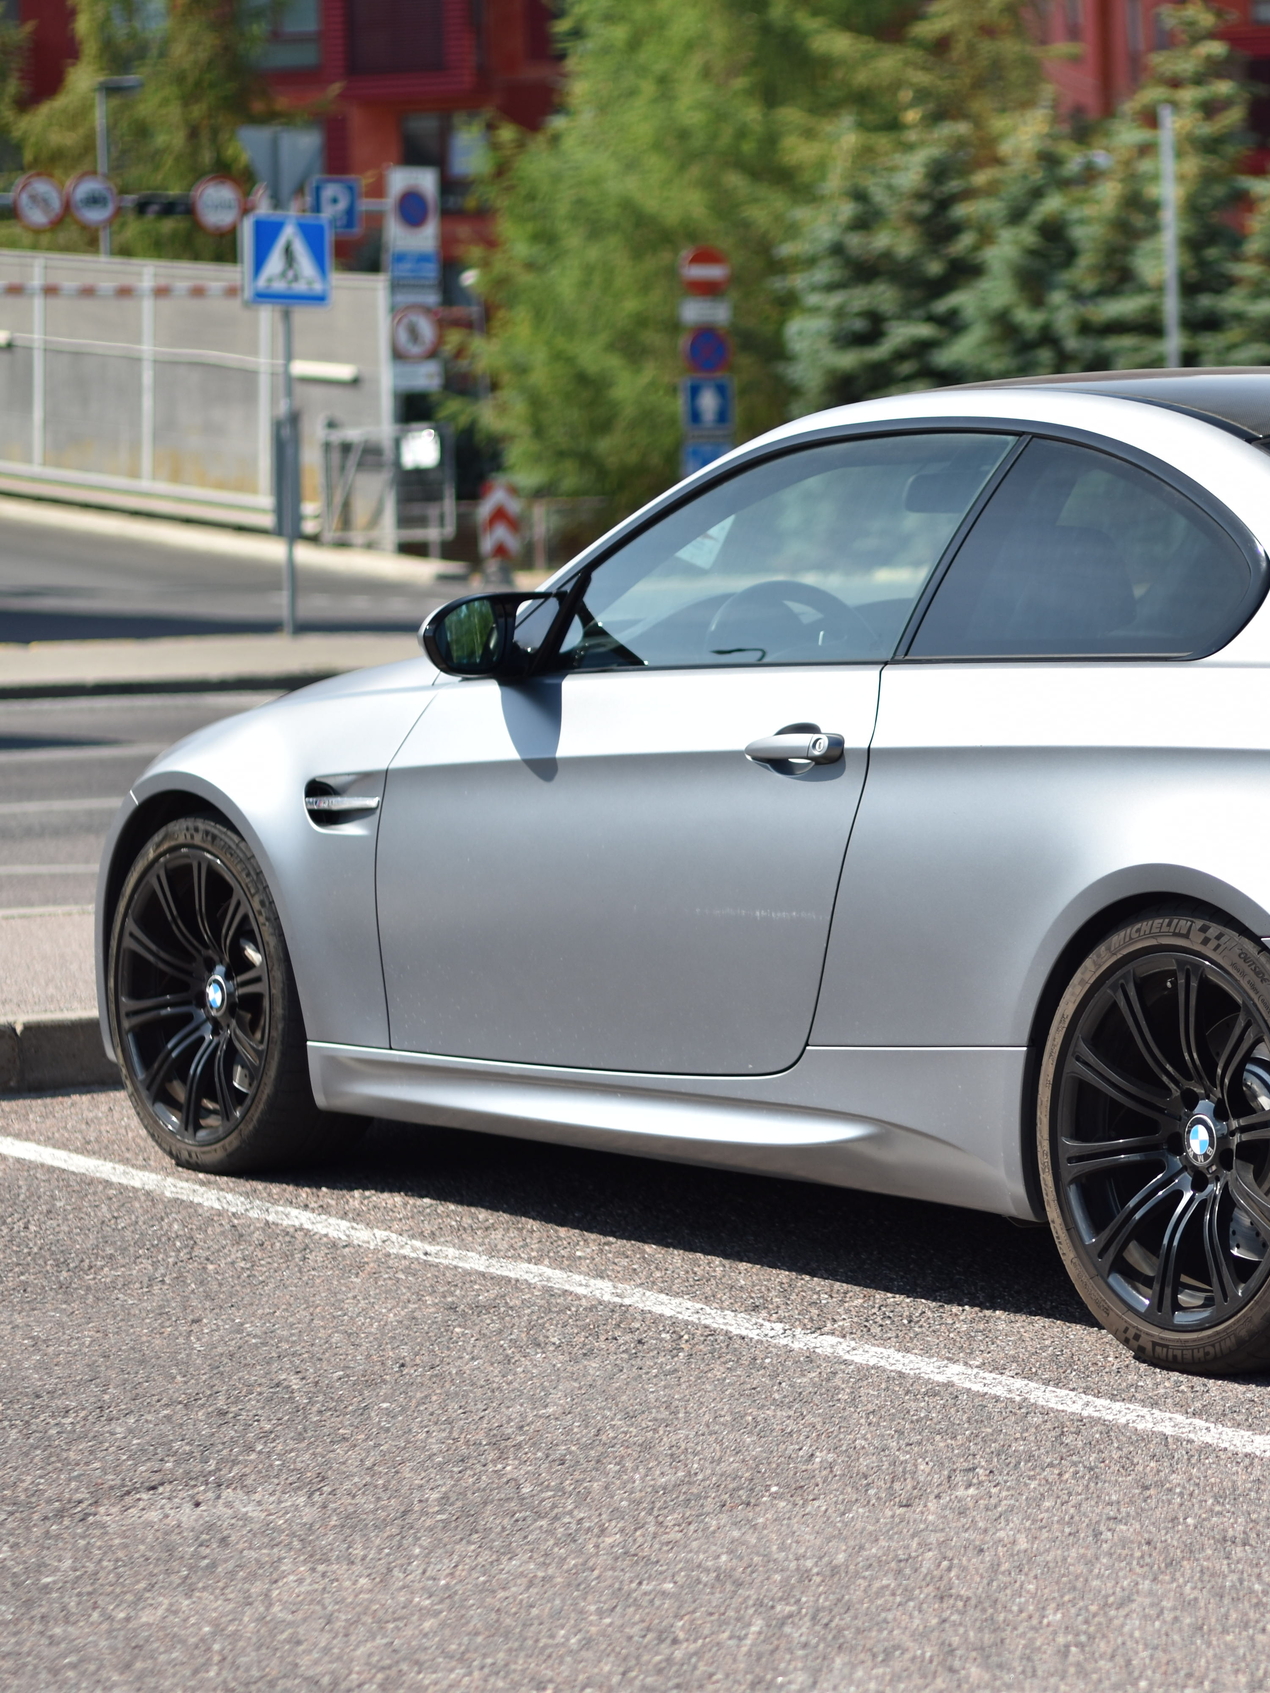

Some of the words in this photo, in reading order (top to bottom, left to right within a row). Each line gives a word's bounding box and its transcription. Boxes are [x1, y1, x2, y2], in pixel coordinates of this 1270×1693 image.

[1111, 918, 1193, 950] MICHELIN
[1238, 951, 1270, 985] OUTSIDE
[1187, 1146, 1214, 1163] BMW
[1154, 1335, 1238, 1364] MICHELIN
